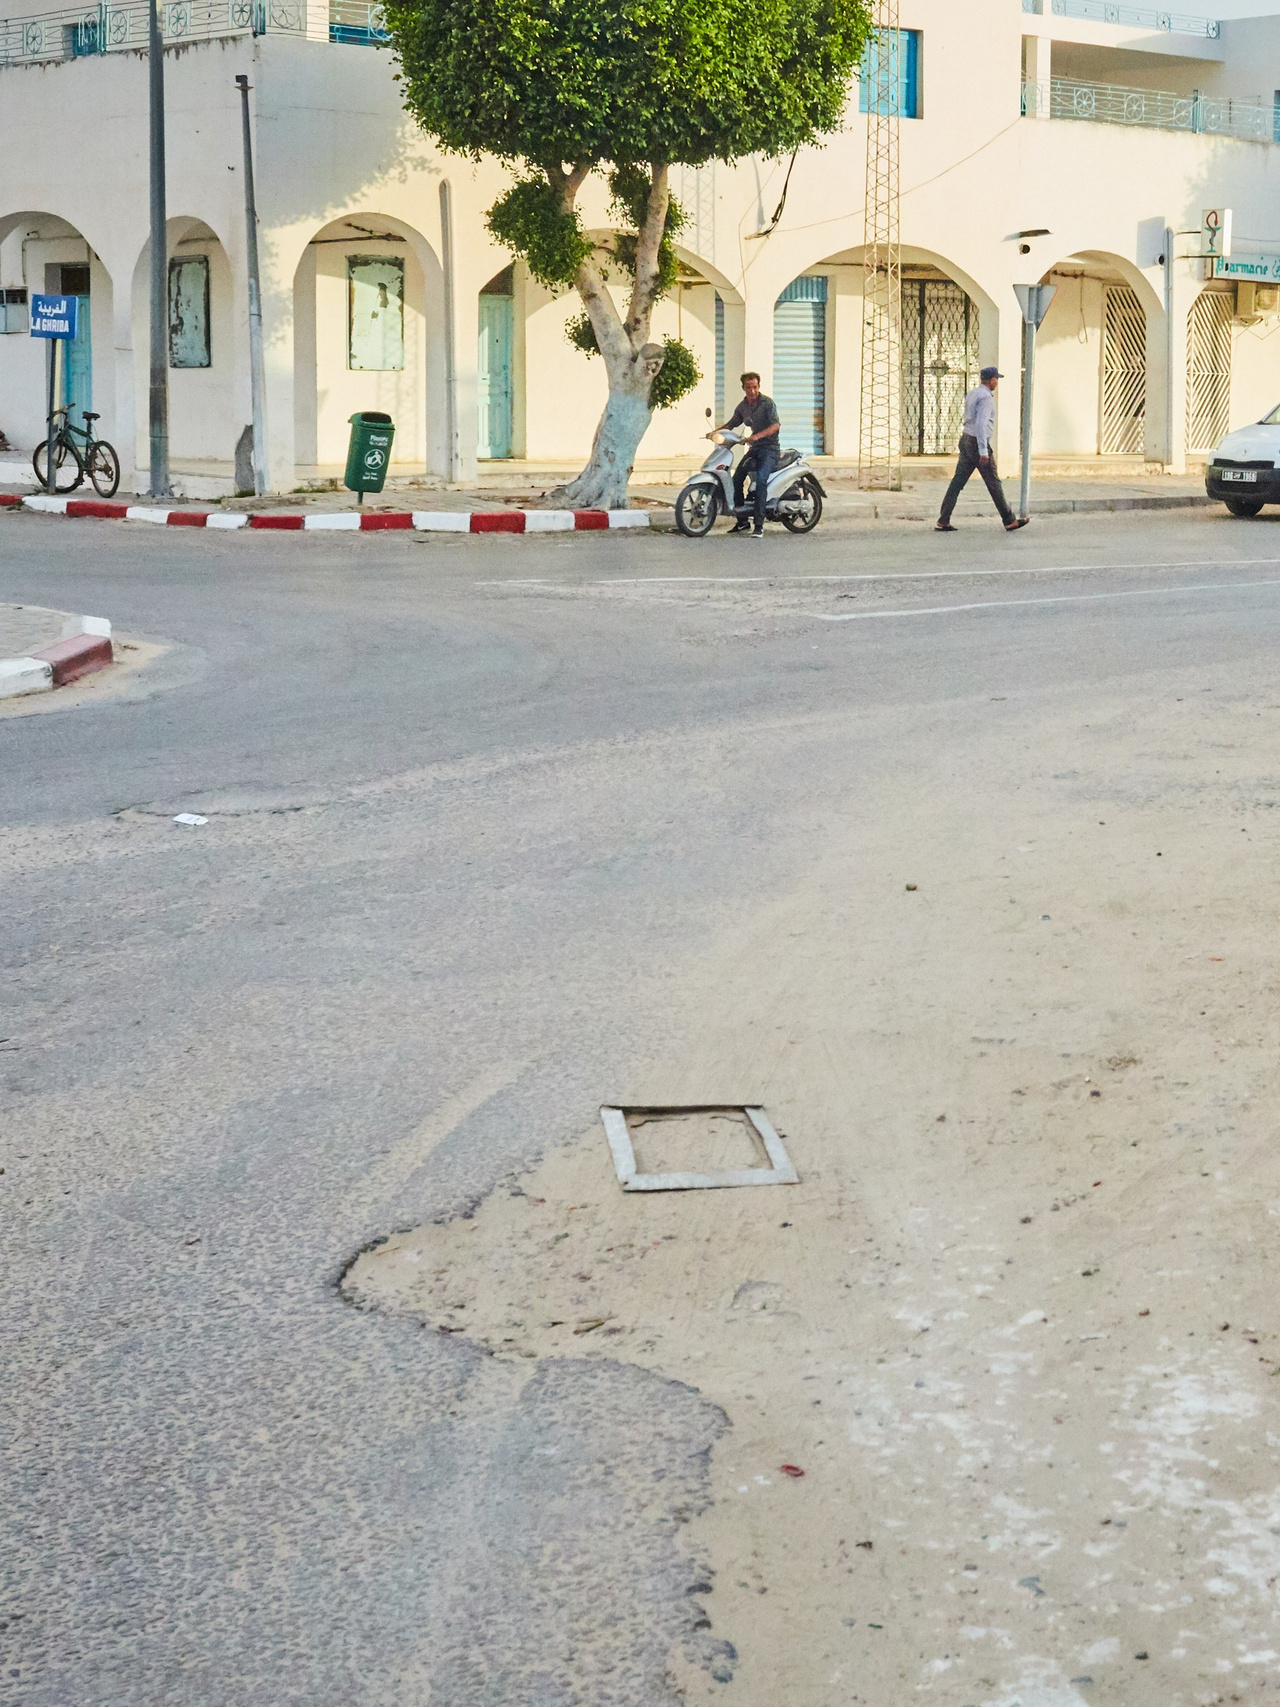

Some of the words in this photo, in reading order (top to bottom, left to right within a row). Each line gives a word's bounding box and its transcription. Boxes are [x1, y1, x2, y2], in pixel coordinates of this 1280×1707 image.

[1215, 256, 1268, 276] Parmacie
[38, 299, 67, 317] الغريبة
[31, 316, 41, 330] LA
[41, 318, 69, 333] GHRIBA
